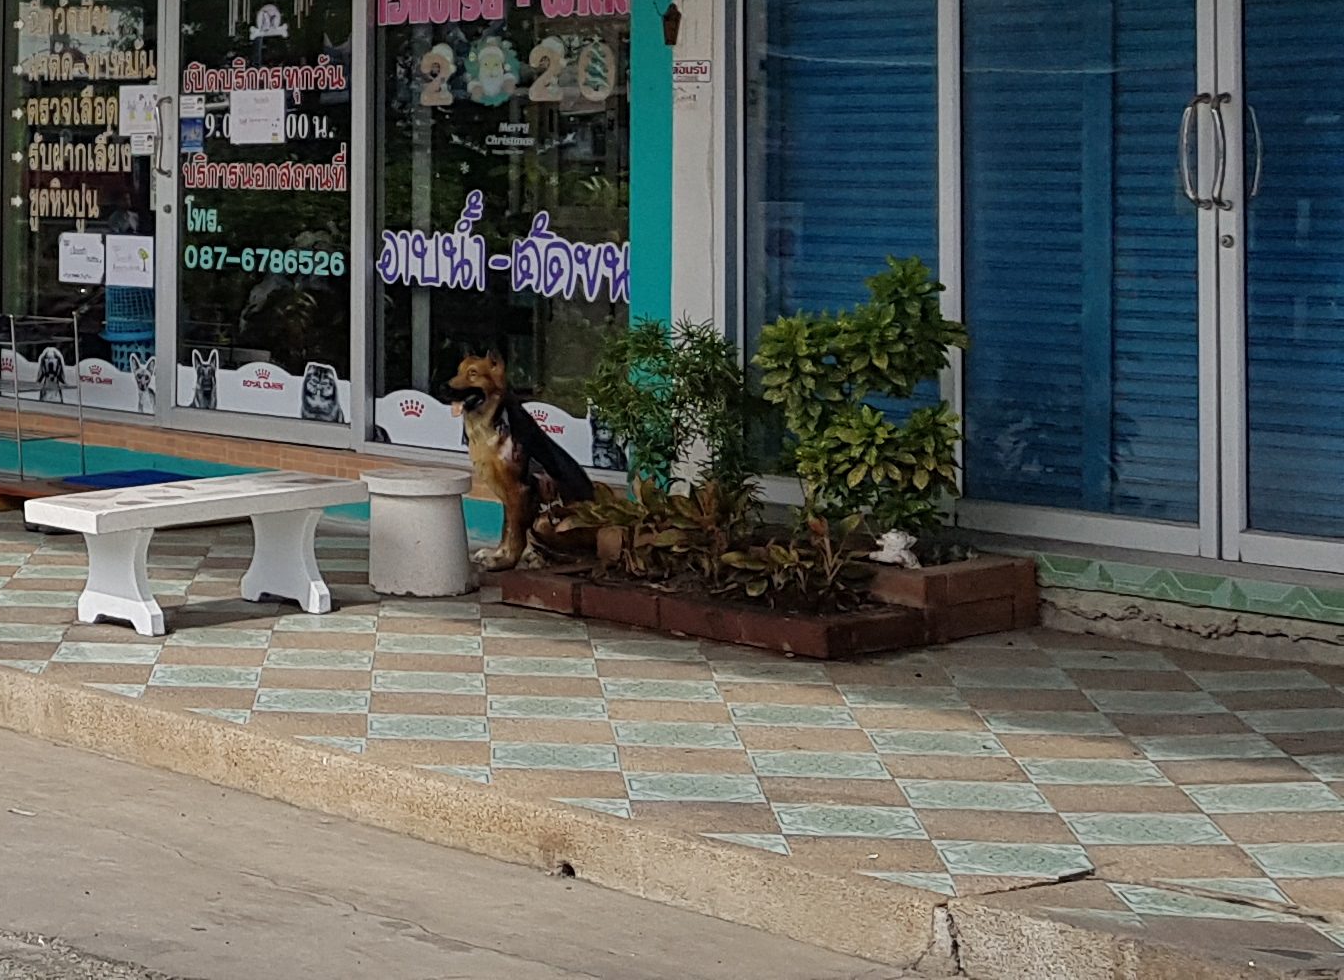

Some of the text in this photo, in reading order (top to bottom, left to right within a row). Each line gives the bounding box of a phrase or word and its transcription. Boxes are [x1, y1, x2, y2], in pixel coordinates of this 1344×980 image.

[27, 84, 119, 125] ตรวจเลือด
[205, 113, 231, 138] 9.0
[485, 135, 534, 146] Christmas
[499, 122, 530, 133] Merry
[29, 124, 132, 172] รับฝากเลี้ยง
[183, 142, 347, 191] บริการนอกสถานที่
[29, 177, 100, 232] ขูดหินปูน
[184, 195, 223, 232] โทร.
[184, 244, 345, 276] 087-6786526
